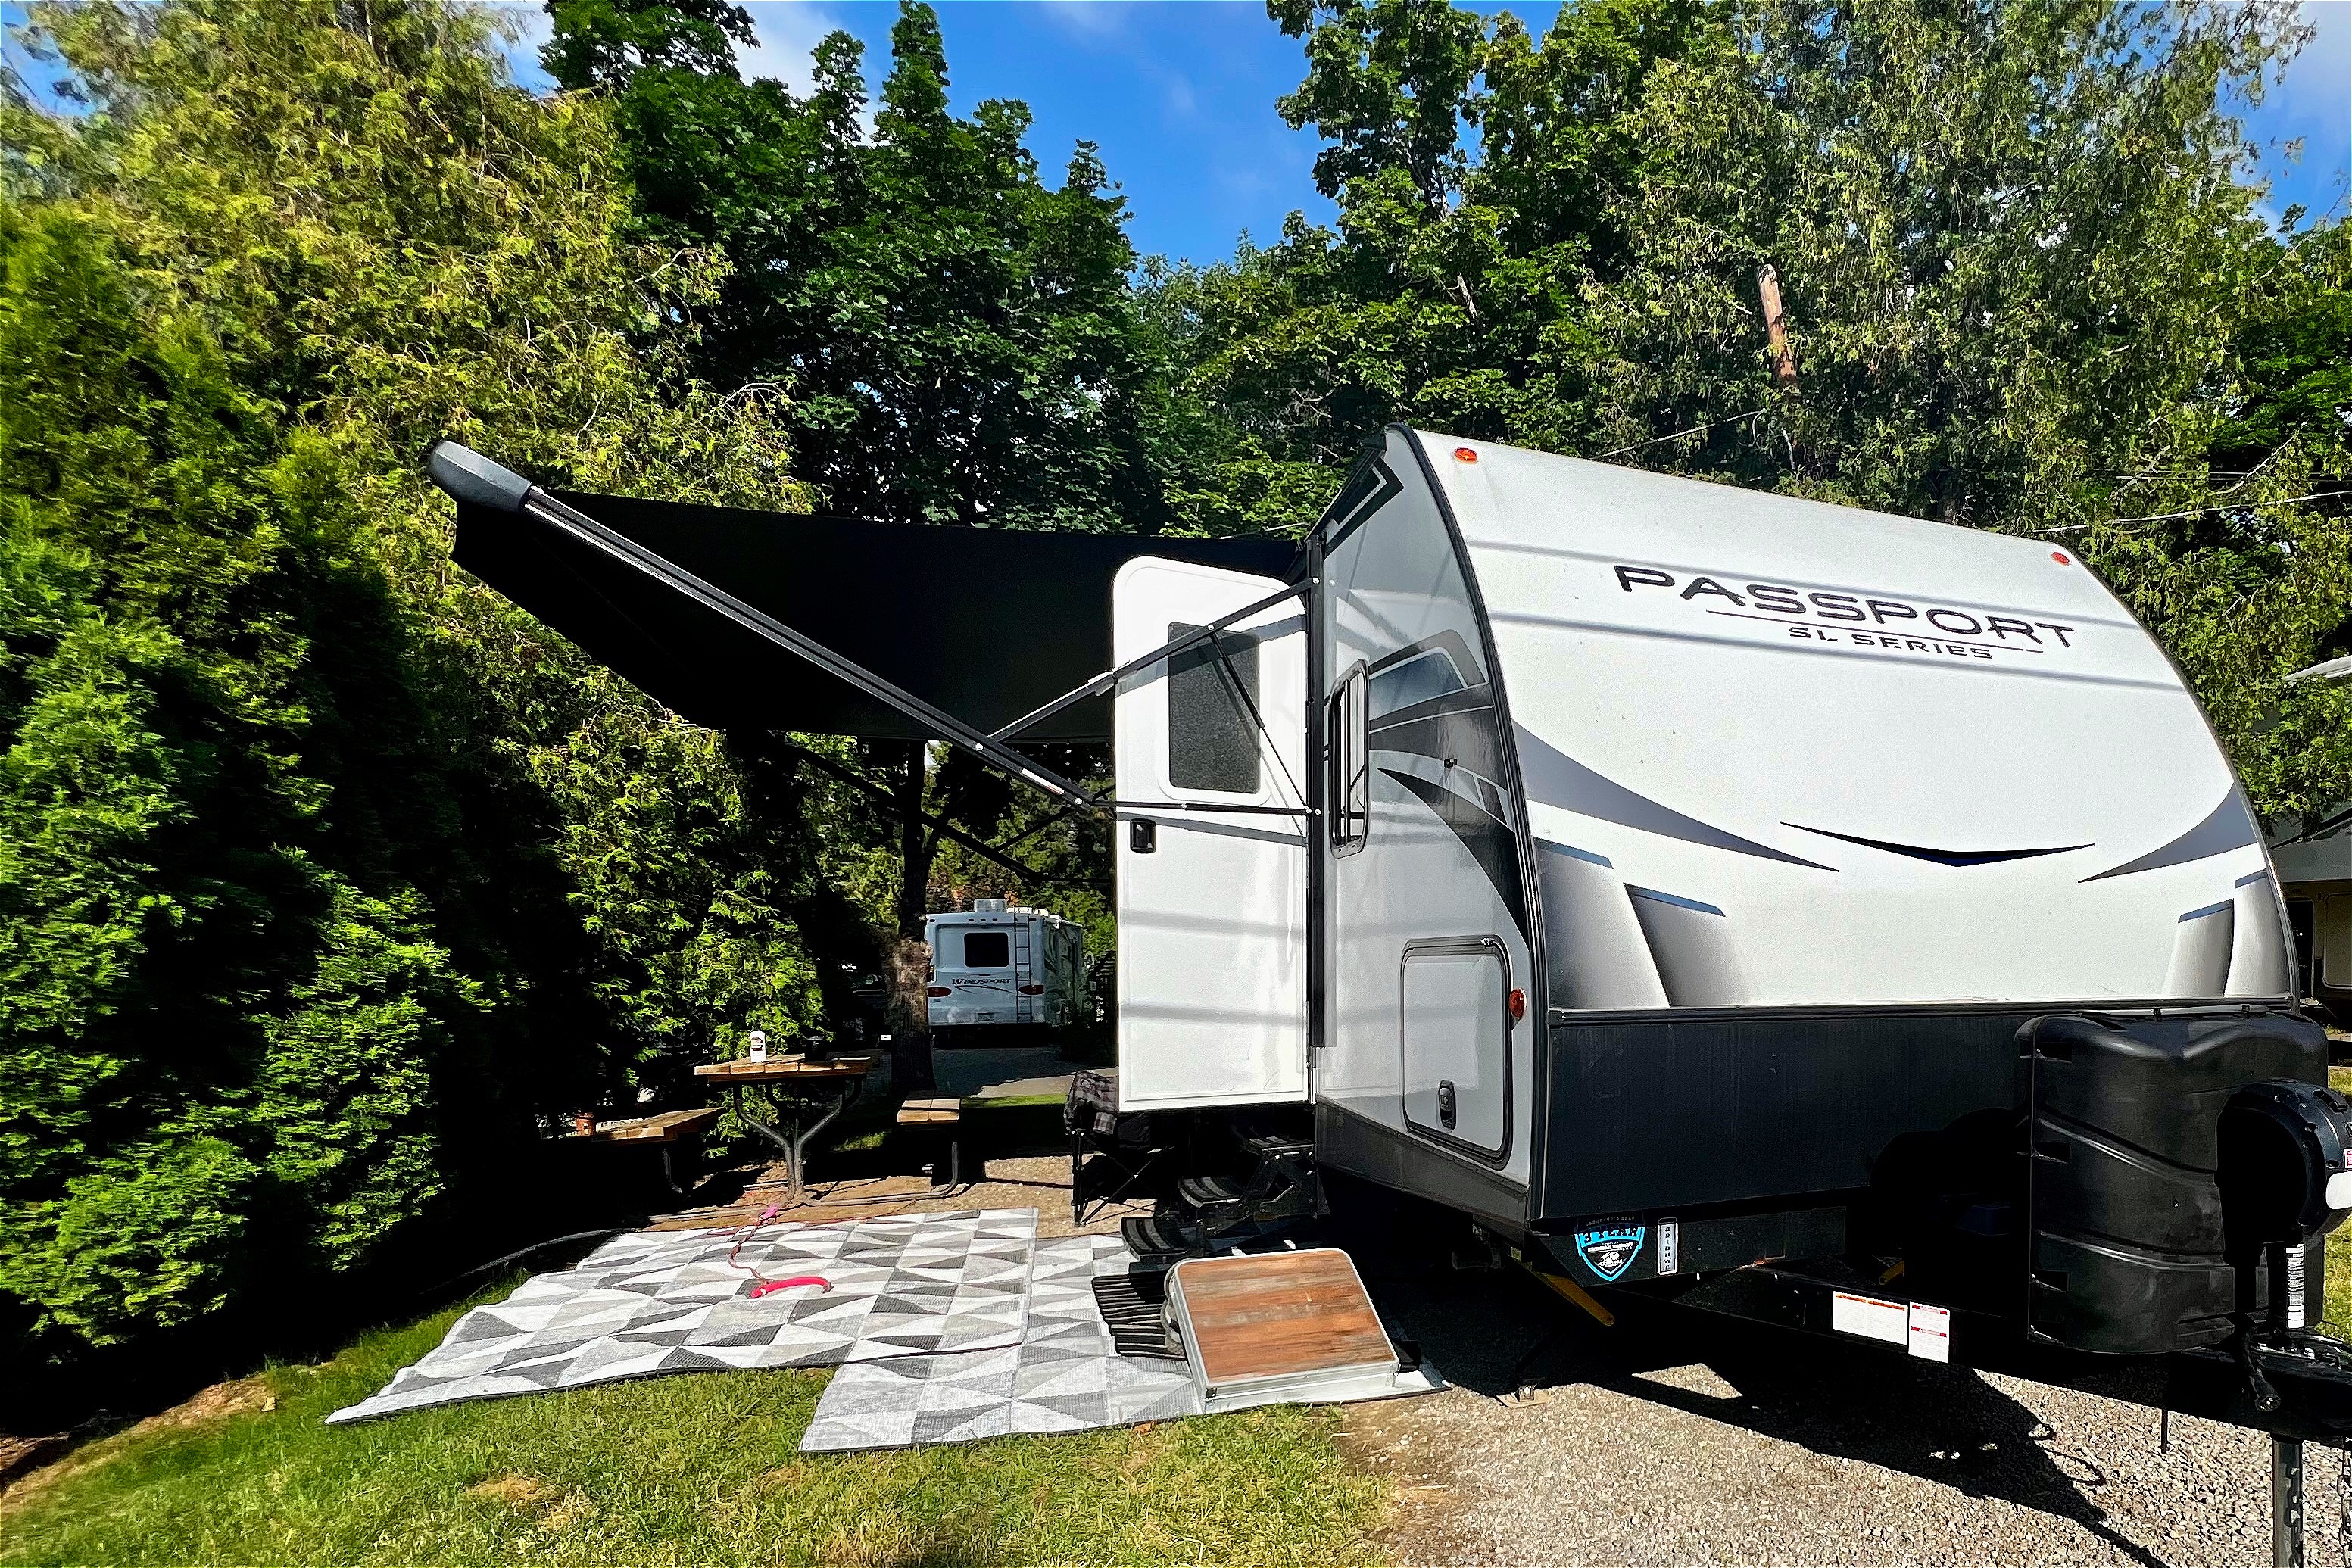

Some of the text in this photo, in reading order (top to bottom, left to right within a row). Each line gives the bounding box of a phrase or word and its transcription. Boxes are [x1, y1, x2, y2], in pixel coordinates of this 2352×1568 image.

[1613, 564, 2075, 648] PASSPORT
[1788, 627, 1993, 659] SL SERIES
[1596, 1224, 1639, 1240] YEAR
